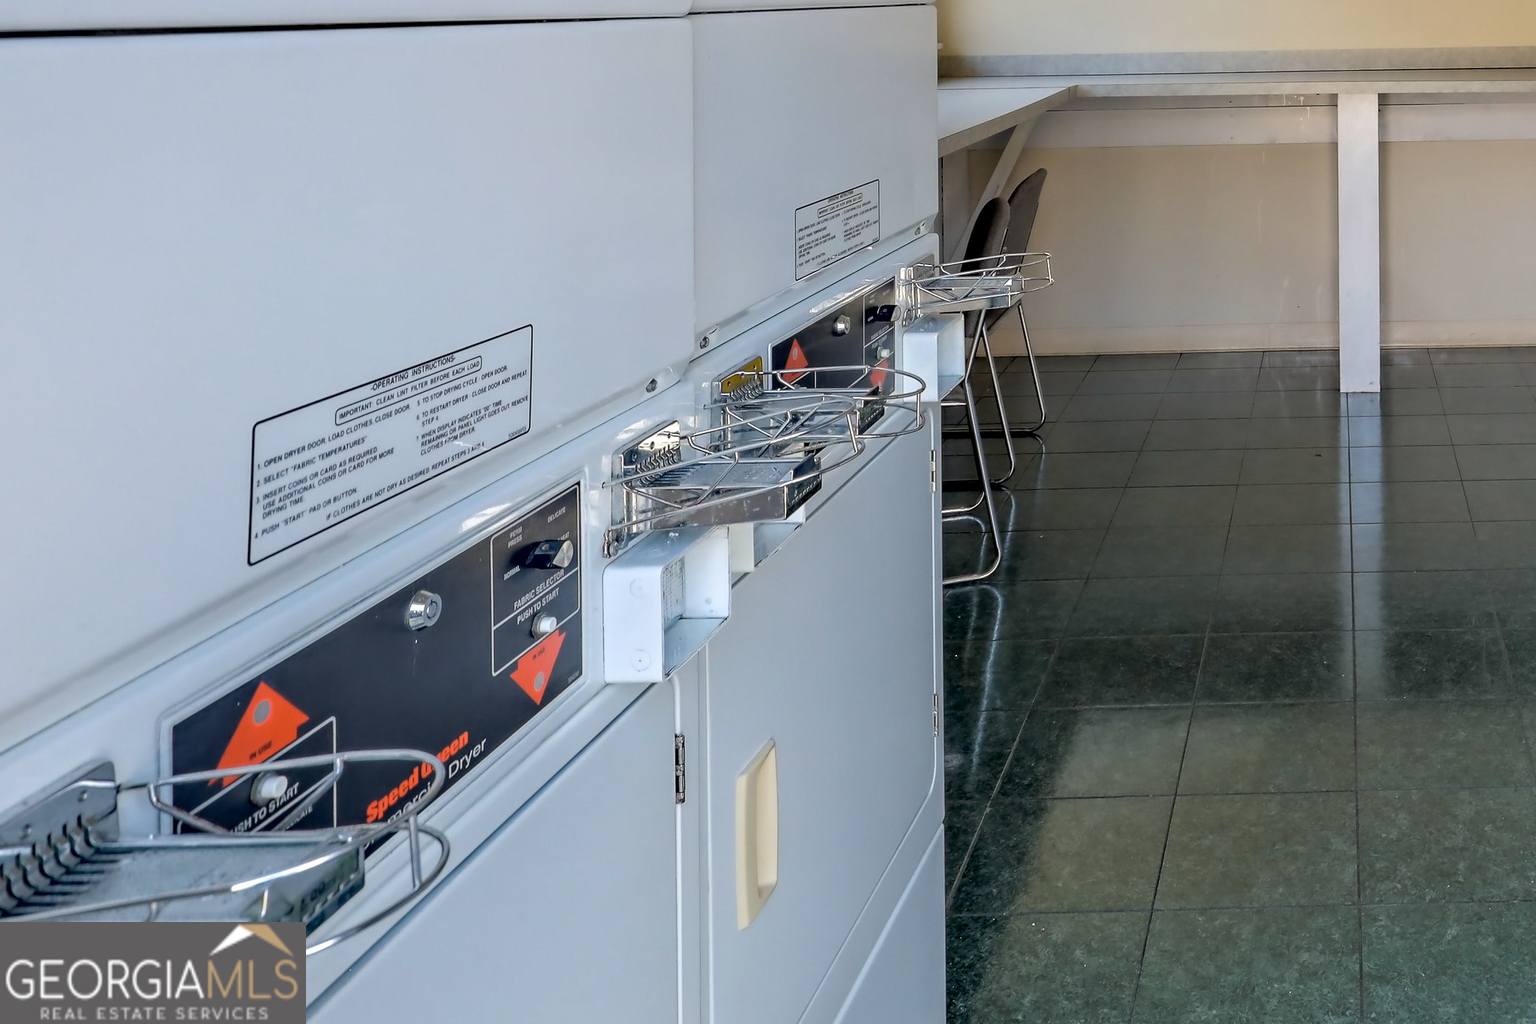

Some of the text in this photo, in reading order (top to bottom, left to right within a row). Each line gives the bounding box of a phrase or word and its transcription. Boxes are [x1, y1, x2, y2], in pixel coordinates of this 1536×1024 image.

[376, 393, 394, 405] CLEAN
[396, 387, 408, 398] LINT
[410, 380, 428, 392] FILTER
[430, 372, 449, 384] BEFORE
[452, 366, 465, 376] EACH
[467, 360, 480, 370] LOAD
[263, 455, 282, 467] OPEN
[284, 445, 306, 460] DRYER
[328, 430, 345, 442] LOAD
[374, 410, 393, 423] CLOSE
[262, 485, 286, 500] INSERT
[287, 476, 308, 490] COINS
[309, 471, 319, 480] OR
[319, 463, 337, 476] CARD
[338, 459, 346, 468] AS
[348, 446, 377, 463] REQUIRED
[263, 467, 288, 484] SELECT
[508, 534, 522, 548] PRESS
[503, 564, 520, 581] NORMAL
[513, 568, 565, 611] FABRIC SELECTOR
[516, 588, 560, 625] PUSH TO START
[248, 740, 272, 761] IN USE
[448, 738, 487, 780] Dryer
[252, 806, 267, 824] TO
[268, 782, 300, 814] START
[366, 766, 419, 824] Speed
